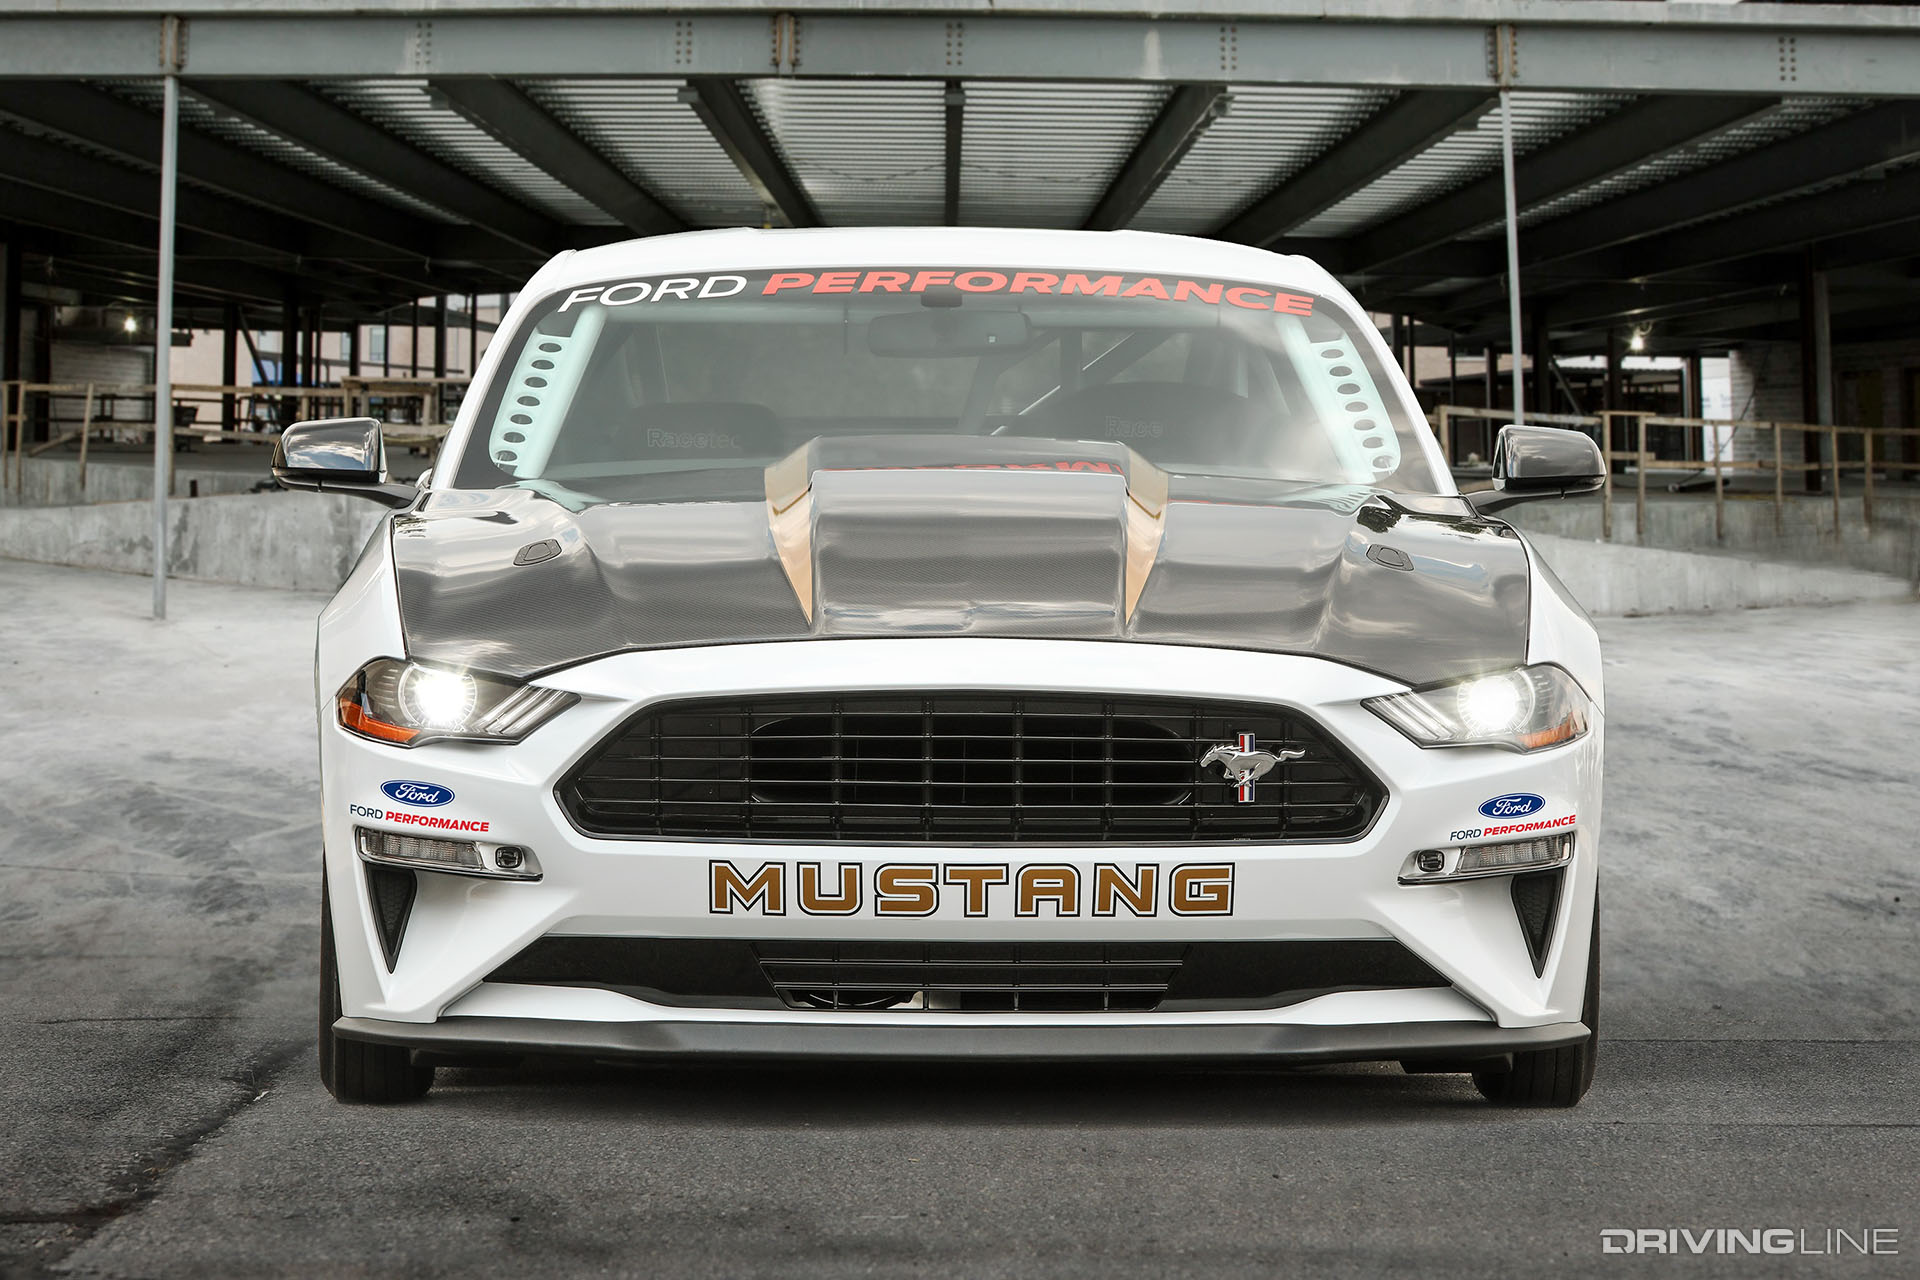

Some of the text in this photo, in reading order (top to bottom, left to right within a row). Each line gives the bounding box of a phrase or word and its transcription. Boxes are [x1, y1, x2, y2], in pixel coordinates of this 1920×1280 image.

[557, 271, 1314, 317] FORD PERFORMANCE
[396, 783, 440, 804] Ford
[1492, 797, 1532, 816] Ford
[350, 804, 489, 832] FORD PERFORMANCE
[1450, 814, 1576, 841] FORD PERFORMANCE
[708, 859, 1236, 918] MUSTANG
